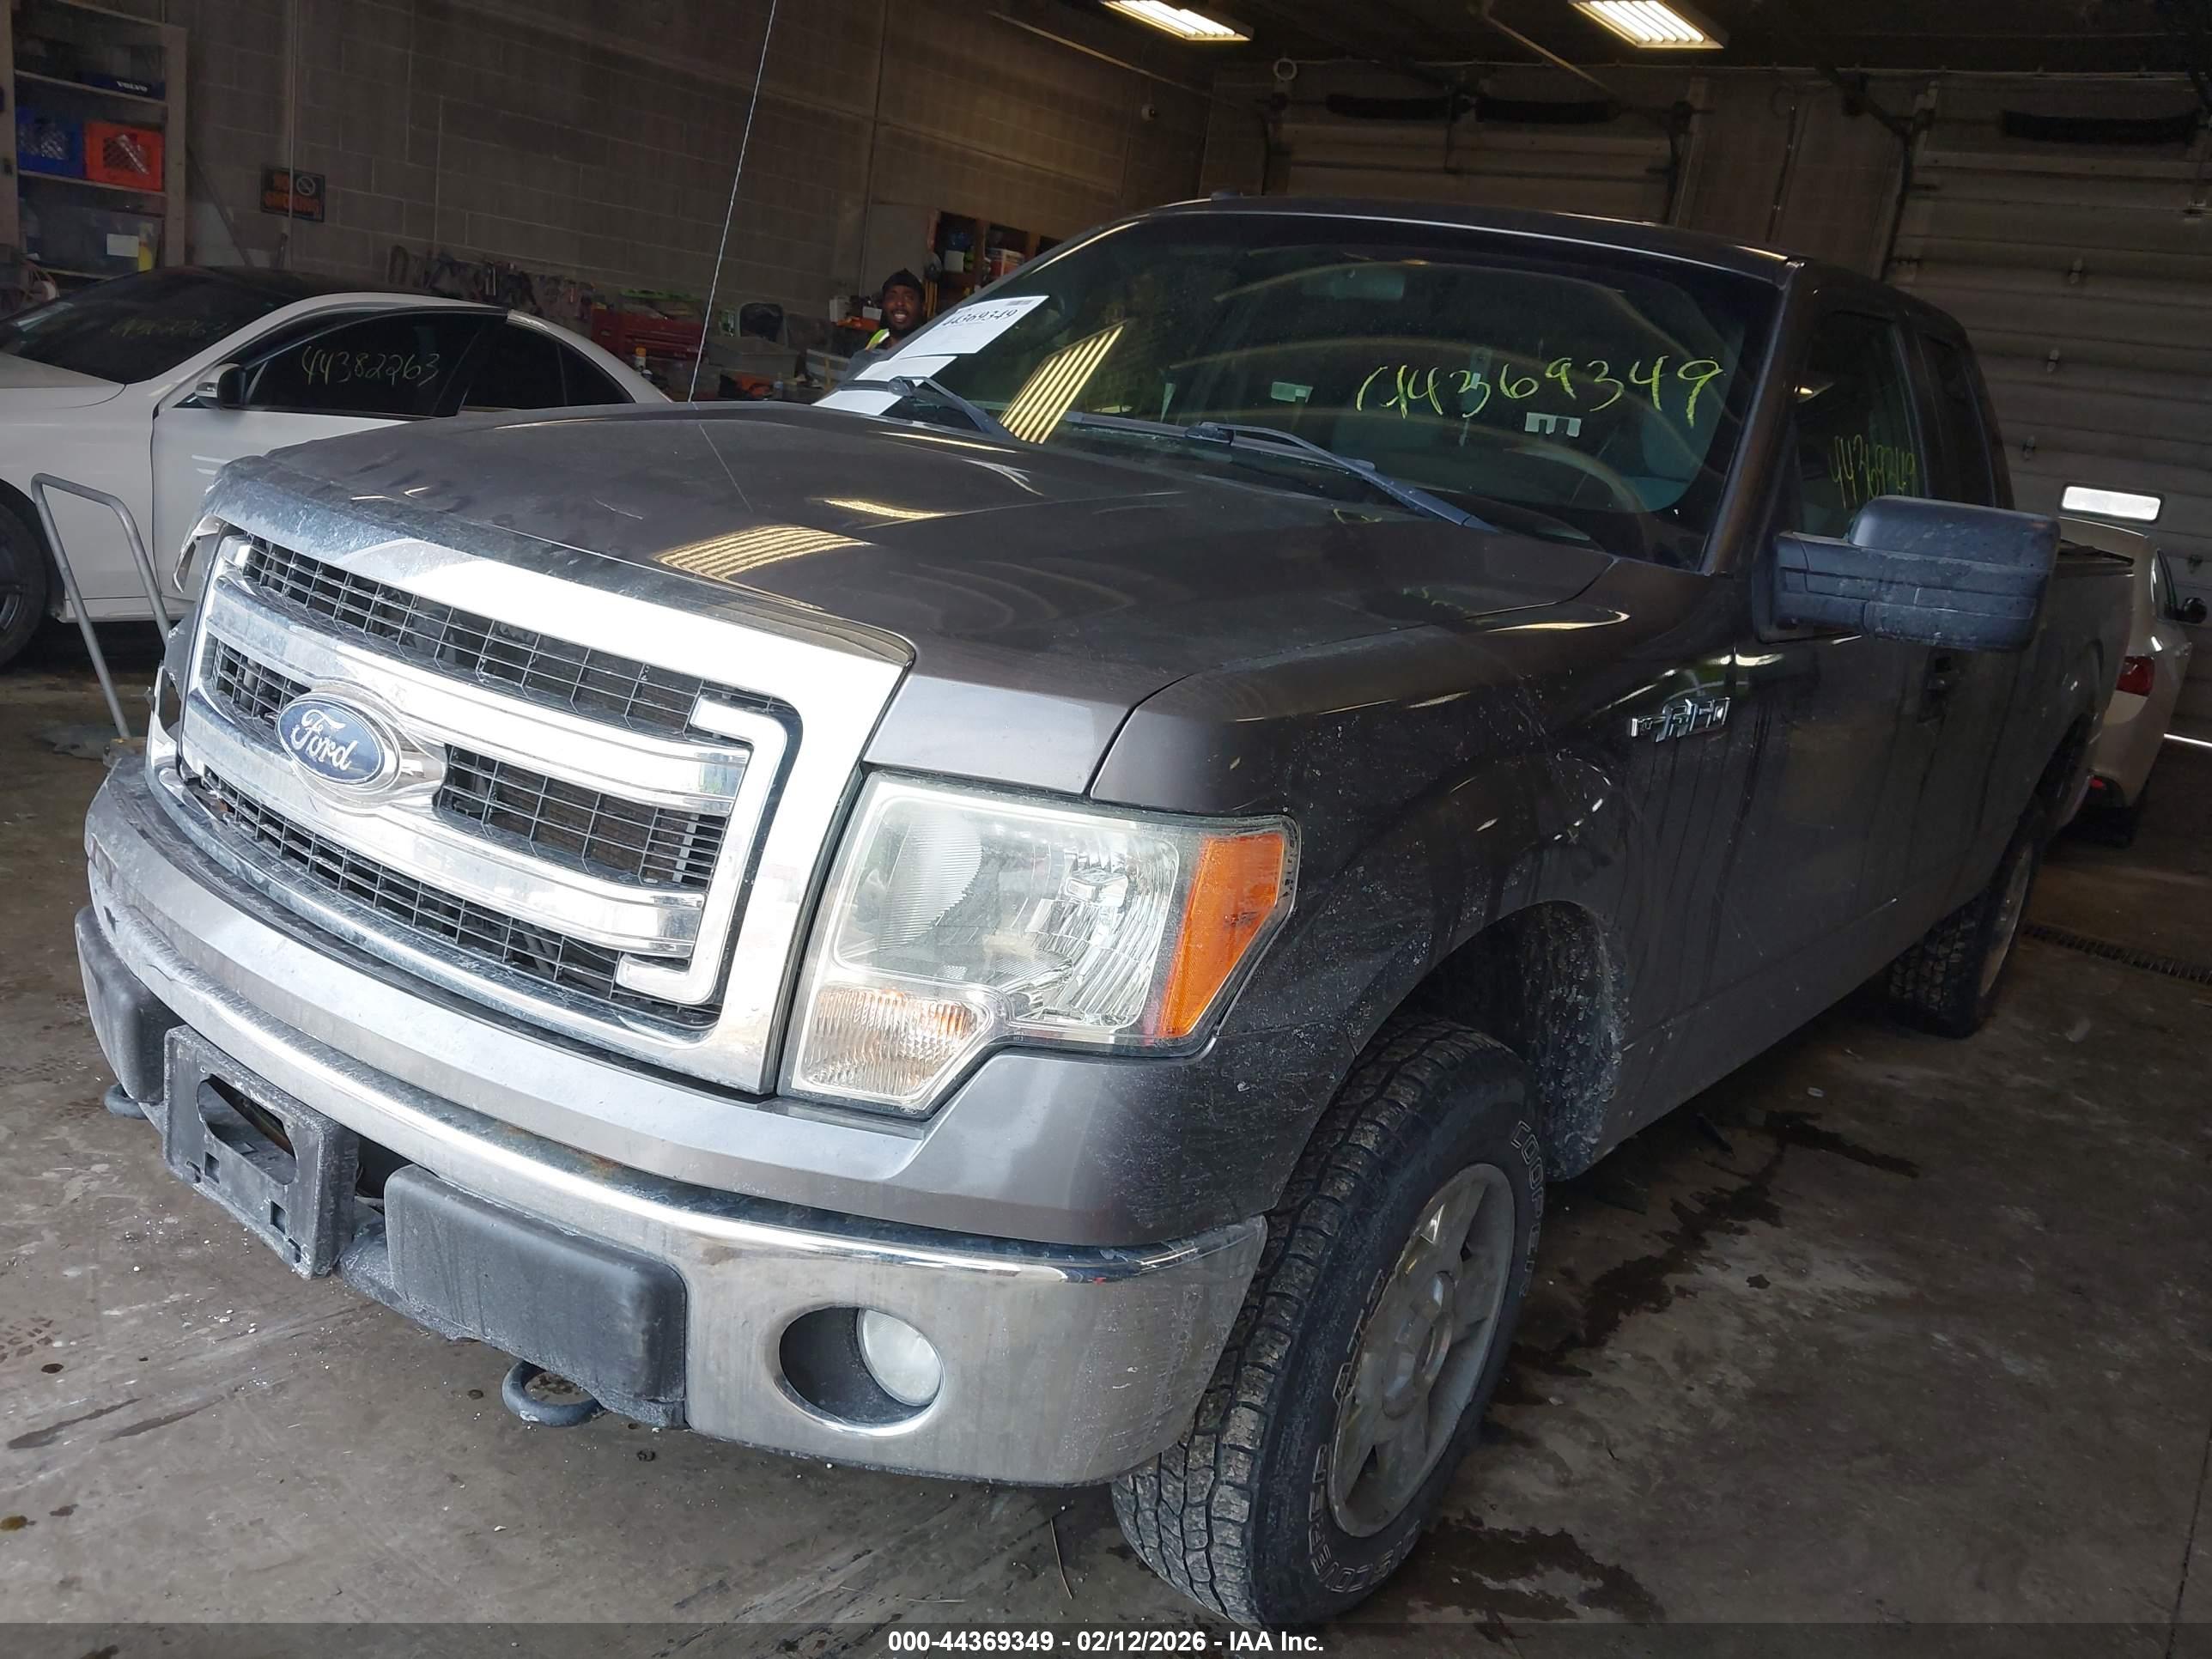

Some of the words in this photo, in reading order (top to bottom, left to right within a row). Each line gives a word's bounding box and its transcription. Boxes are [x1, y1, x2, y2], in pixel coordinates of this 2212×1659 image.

[116, 81, 148, 93] VOLVO
[301, 345, 441, 387] 44382263
[1356, 356, 1726, 428] 44369349
[289, 708, 360, 771] Ford
